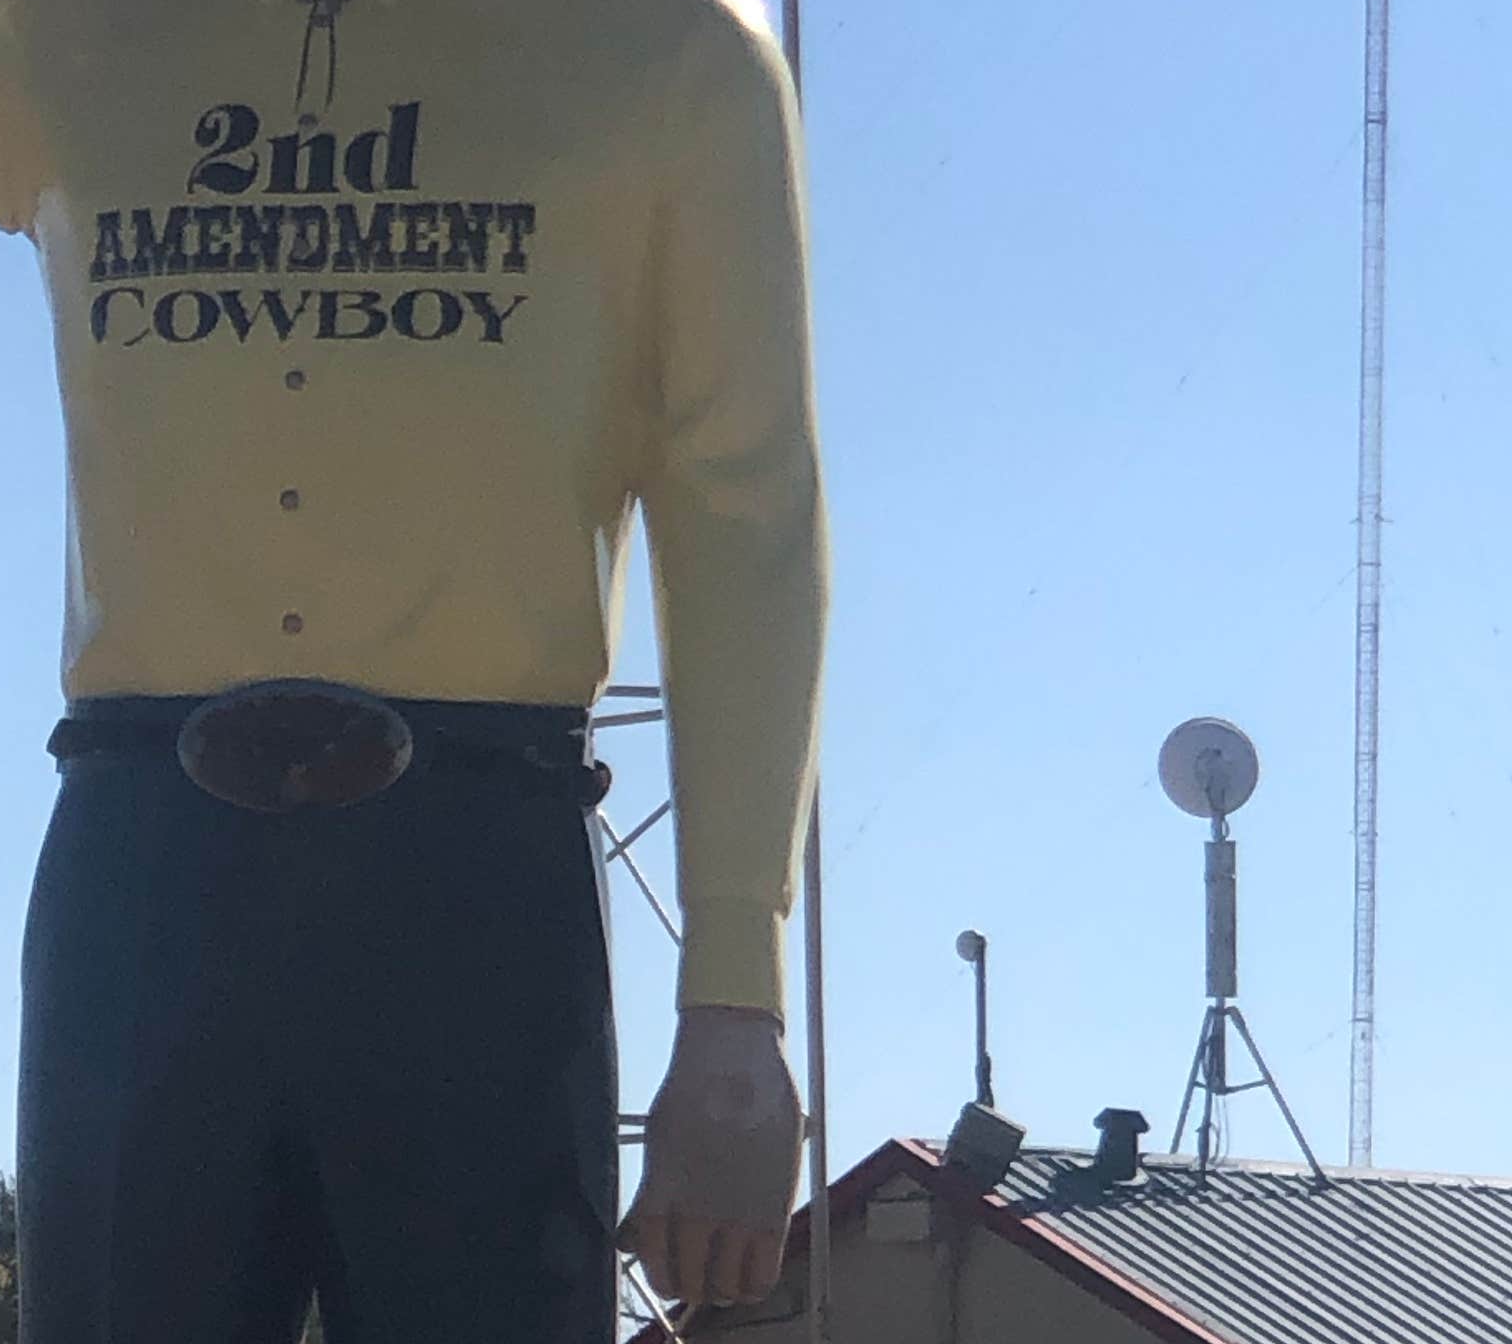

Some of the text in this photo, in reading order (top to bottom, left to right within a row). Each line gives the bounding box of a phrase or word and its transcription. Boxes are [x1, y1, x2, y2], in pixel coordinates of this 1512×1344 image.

[187, 101, 421, 195] 2nd
[90, 202, 536, 283] AMENDMENT
[90, 287, 528, 347] COWBOY
